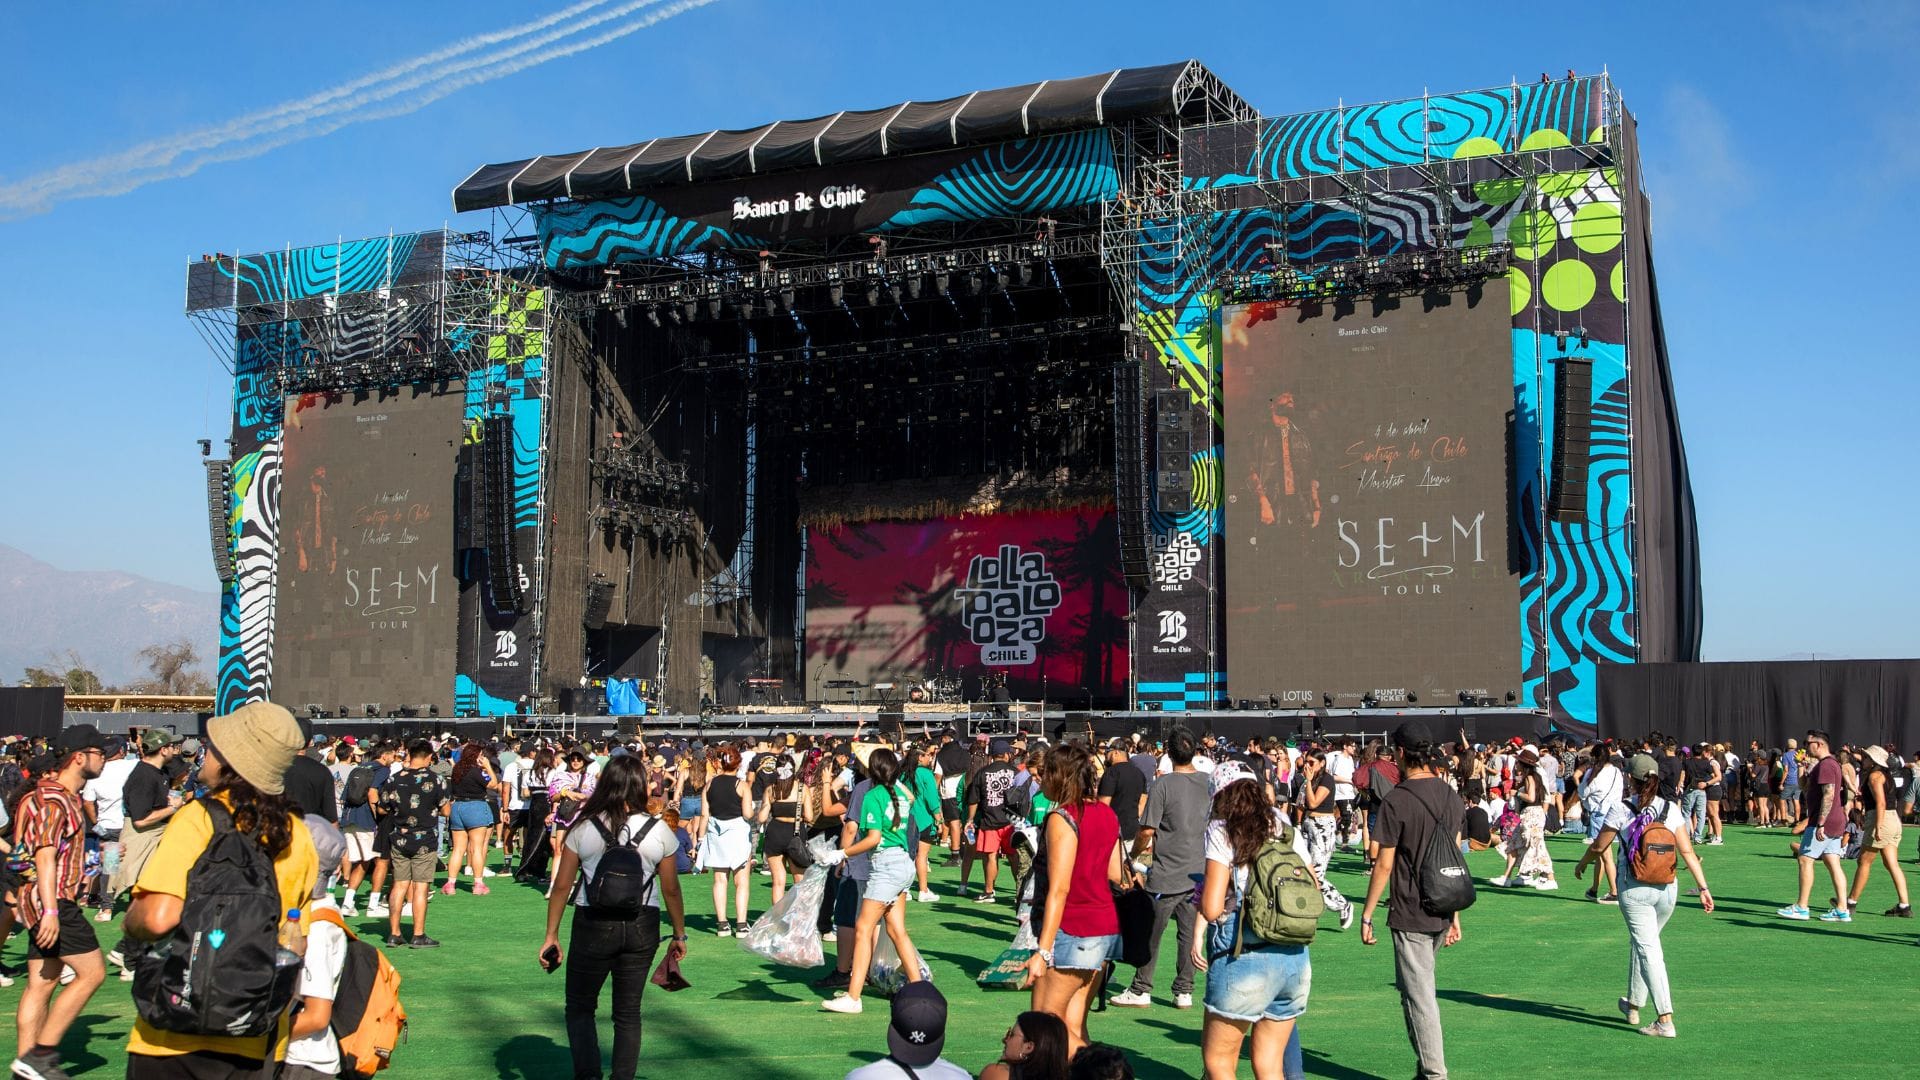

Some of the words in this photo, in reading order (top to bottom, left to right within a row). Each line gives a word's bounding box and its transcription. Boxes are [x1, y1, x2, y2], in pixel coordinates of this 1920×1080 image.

[732, 195, 790, 220] Banco
[794, 191, 815, 212] de
[820, 183, 867, 209] Chile
[1338, 327, 1360, 337] Banco
[1361, 327, 1369, 335] de
[1371, 325, 1388, 334] Chile
[1408, 441, 1421, 459] de
[1431, 436, 1468, 462] Chile
[1380, 584, 1442, 596] TOUR
[370, 620, 408, 629] TOUR
[1152, 645, 1169, 653] Banco
[1178, 645, 1192, 653] Chile
[988, 650, 1027, 661] CHILE
[1283, 690, 1313, 702] LOTUS
[1374, 694, 1406, 702] TICKET
